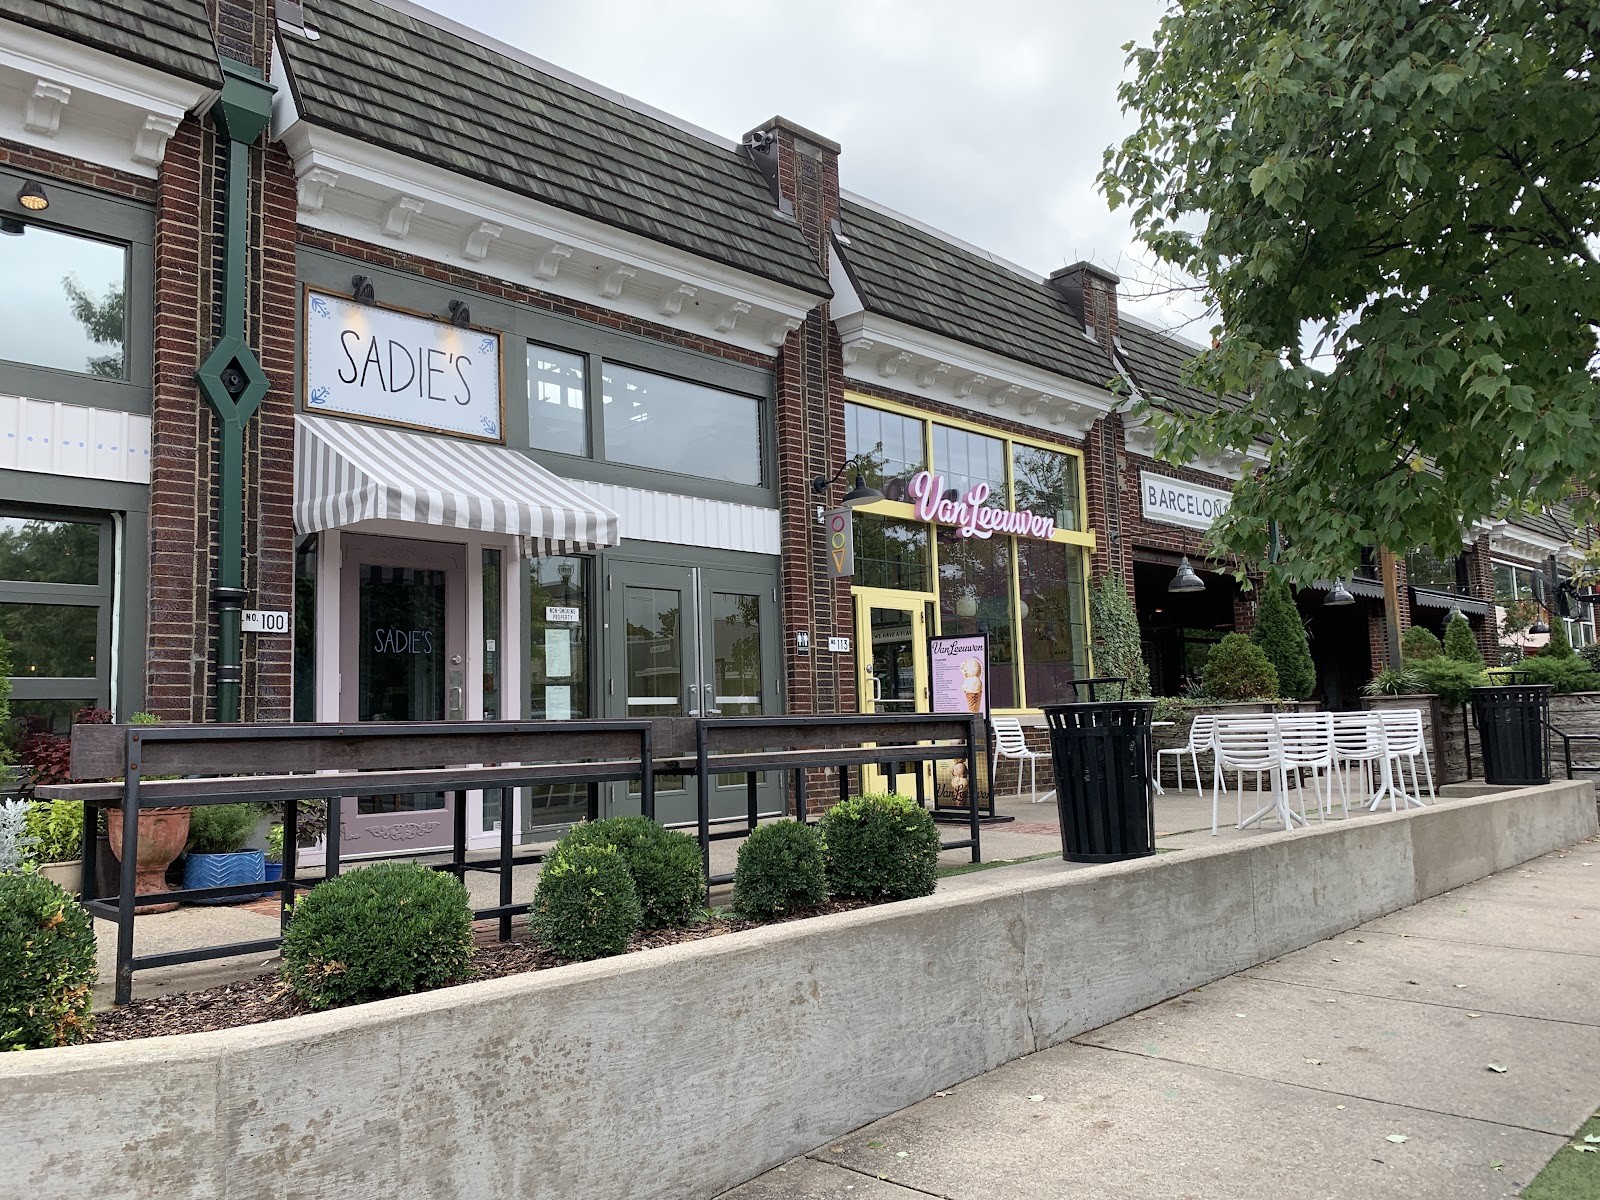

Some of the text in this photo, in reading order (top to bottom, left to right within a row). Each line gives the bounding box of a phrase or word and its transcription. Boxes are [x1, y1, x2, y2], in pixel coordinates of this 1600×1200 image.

[338, 329, 472, 406] SADIE'S
[910, 471, 1056, 539] Van Leeuwen
[262, 614, 284, 630] 100
[374, 628, 433, 654] SADIE'S
[837, 639, 848, 650] 113
[932, 640, 983, 656] Van Leeuwen
